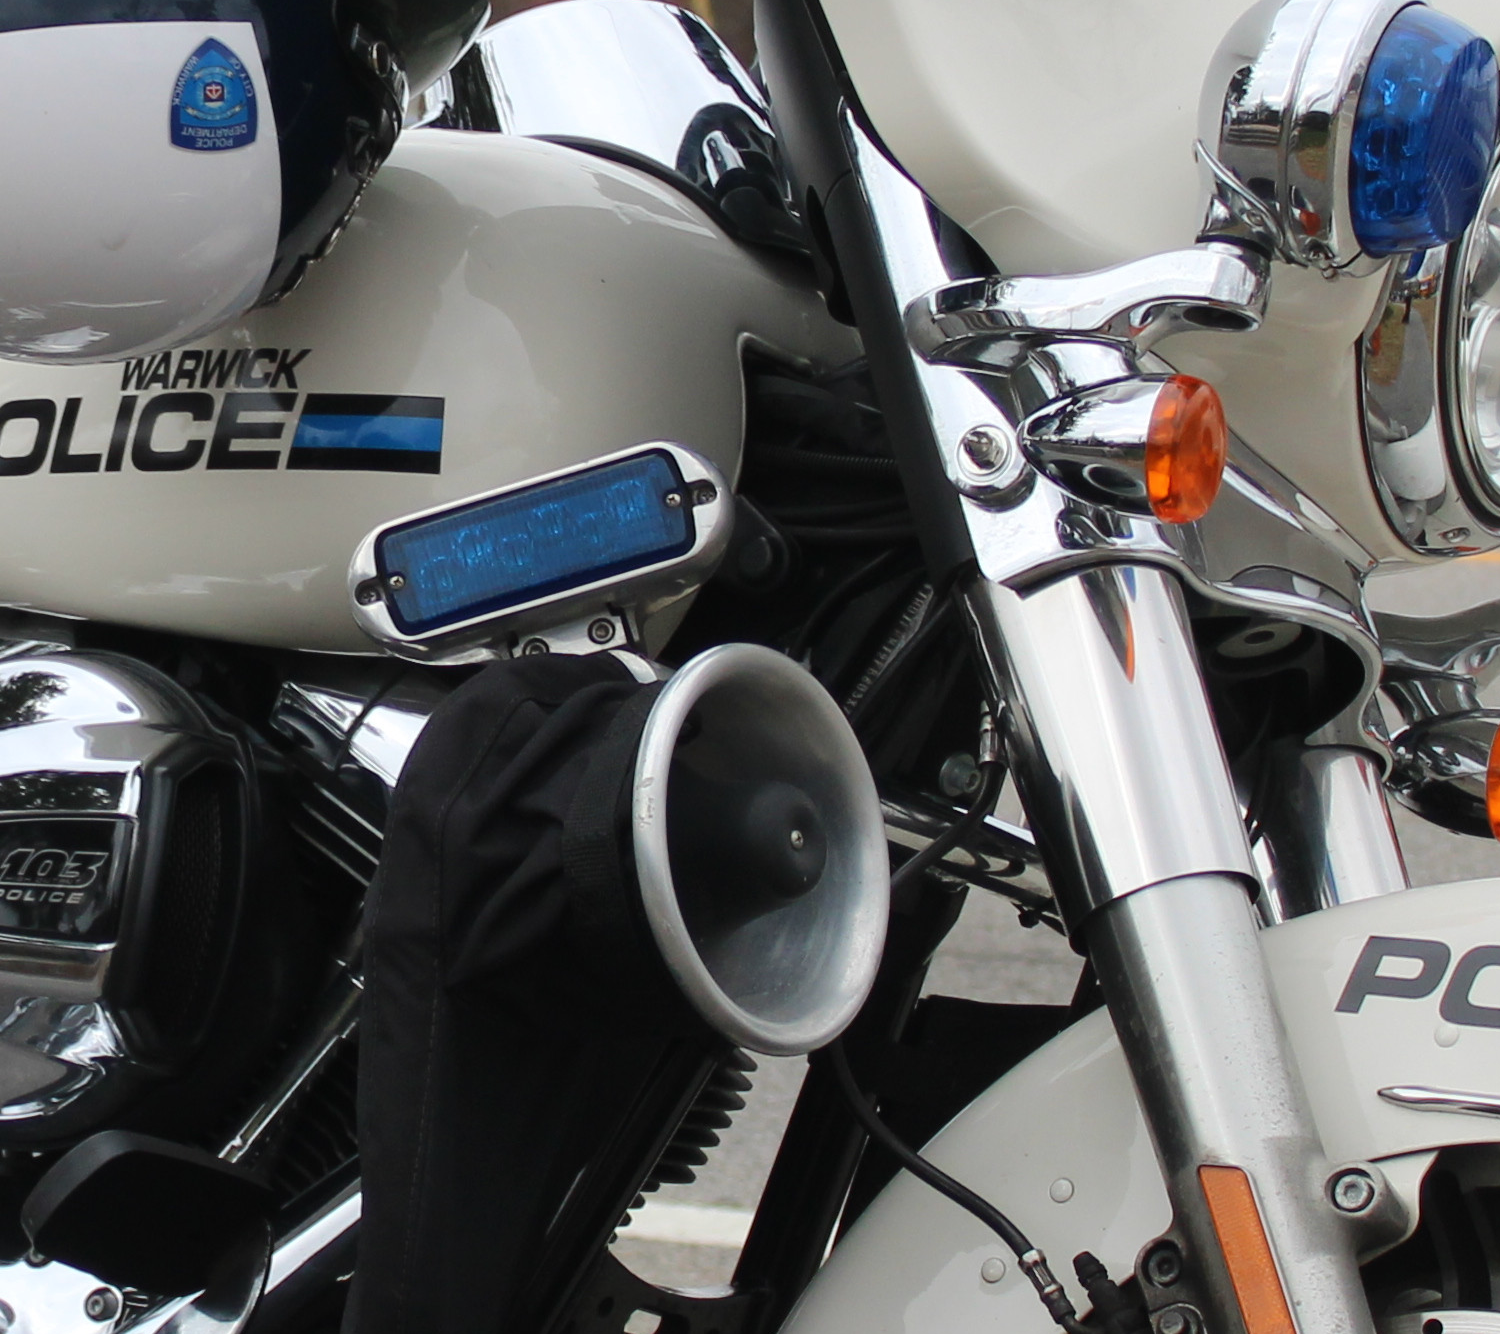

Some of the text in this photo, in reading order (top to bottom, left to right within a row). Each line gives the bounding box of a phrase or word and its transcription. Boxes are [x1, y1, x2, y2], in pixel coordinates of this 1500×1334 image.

[181, 124, 248, 138] DEPARTMENT
[195, 137, 235, 148] POLICE
[120, 348, 313, 391] WARWICK
